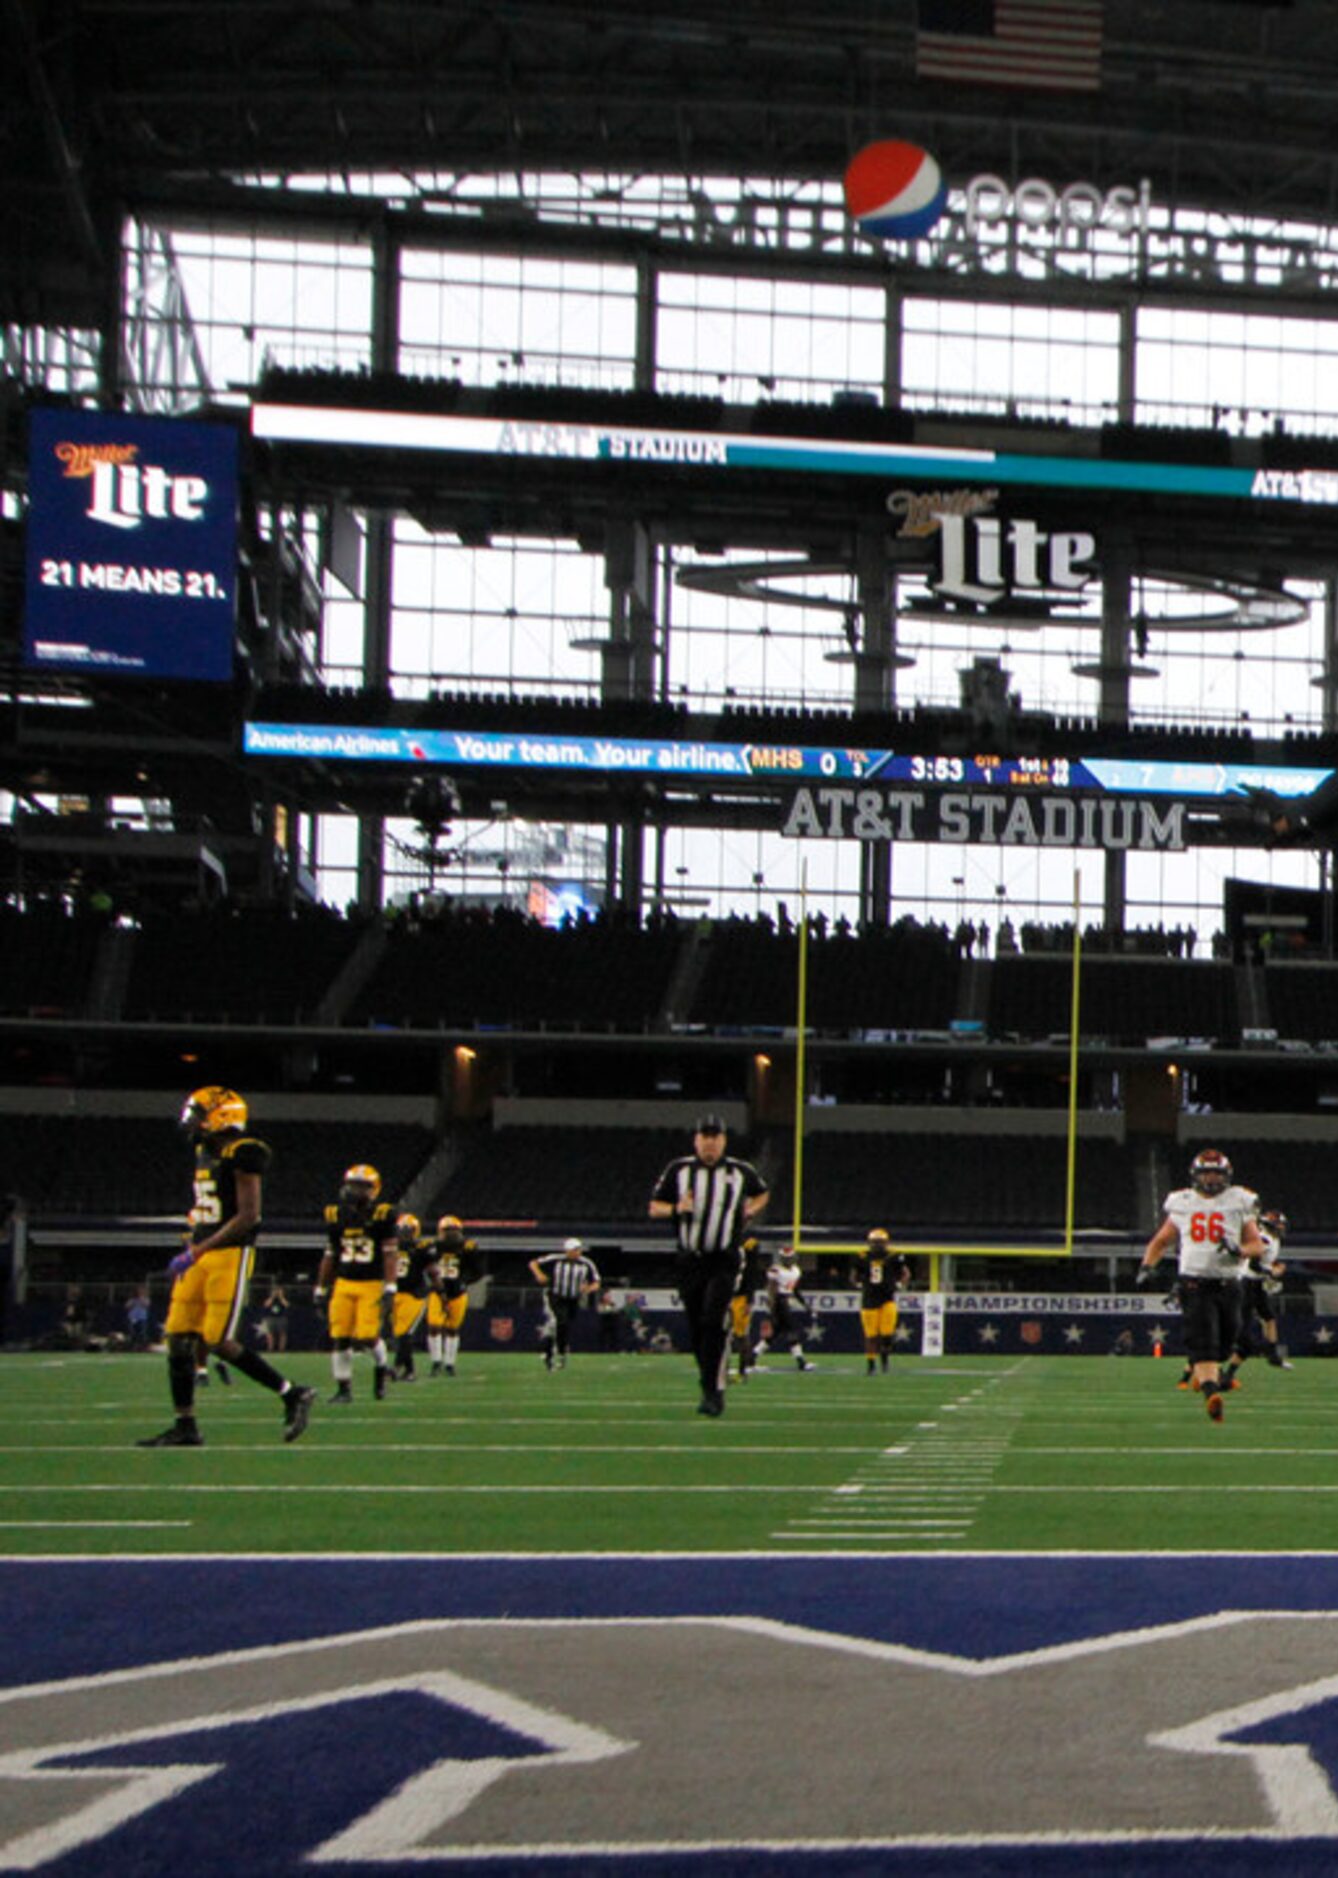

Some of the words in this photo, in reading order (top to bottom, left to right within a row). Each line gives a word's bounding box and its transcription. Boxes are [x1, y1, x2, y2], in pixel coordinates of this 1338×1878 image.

[607, 434, 728, 465] STADIUM
[86, 459, 209, 530] Lite
[933, 512, 1096, 604] Lite
[41, 560, 73, 586] 21
[80, 563, 181, 595] MEANS
[184, 572, 226, 598] 21.
[249, 730, 333, 752] American
[334, 737, 399, 756] Airlines
[454, 734, 510, 762] Your
[519, 741, 590, 765] team.
[594, 742, 652, 767] Your
[658, 745, 741, 771] airline.
[751, 751, 803, 769] MHS
[820, 752, 836, 775] 0
[911, 756, 964, 781] 3:53
[784, 788, 924, 840] AT&T
[938, 795, 1186, 851] STADIUM
[1191, 1212, 1224, 1244] 66
[943, 1296, 1145, 1311] HAMPIONSHIPS
